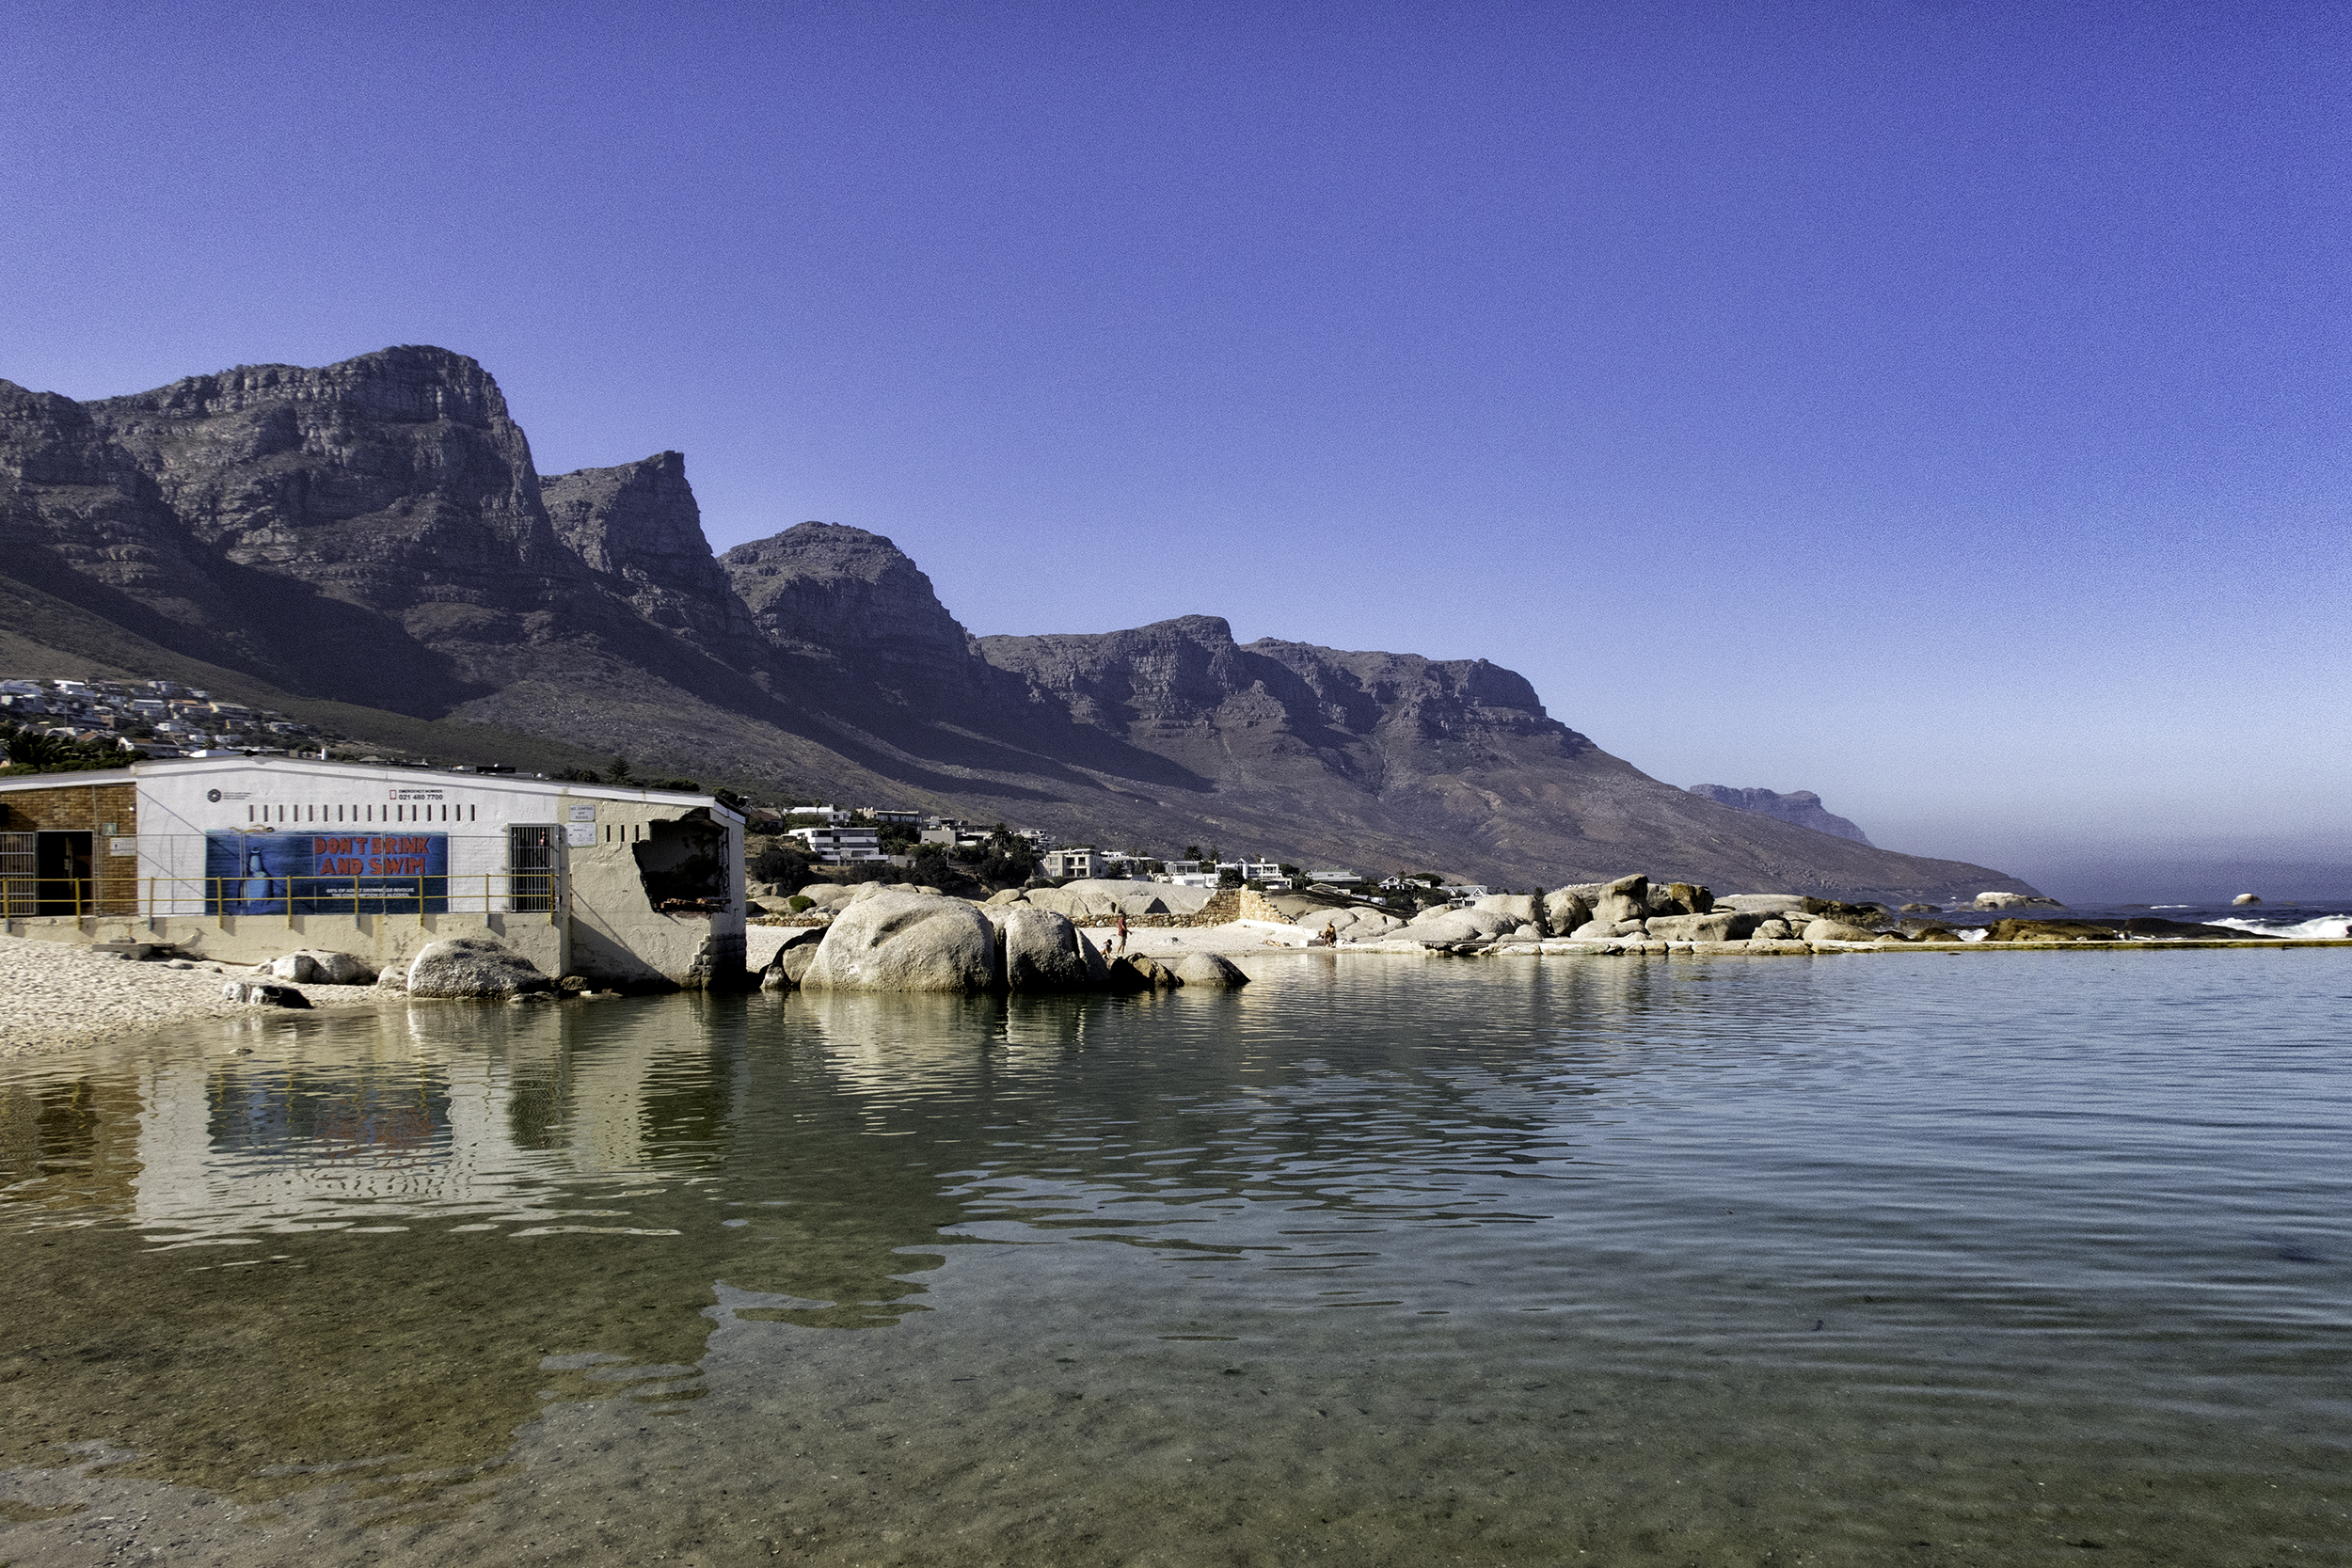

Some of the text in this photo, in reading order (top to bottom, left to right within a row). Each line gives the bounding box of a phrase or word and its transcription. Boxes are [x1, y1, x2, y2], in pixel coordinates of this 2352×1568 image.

[314, 837, 430, 854] DON'T DRINK
[320, 858, 425, 875] AND SWIM
